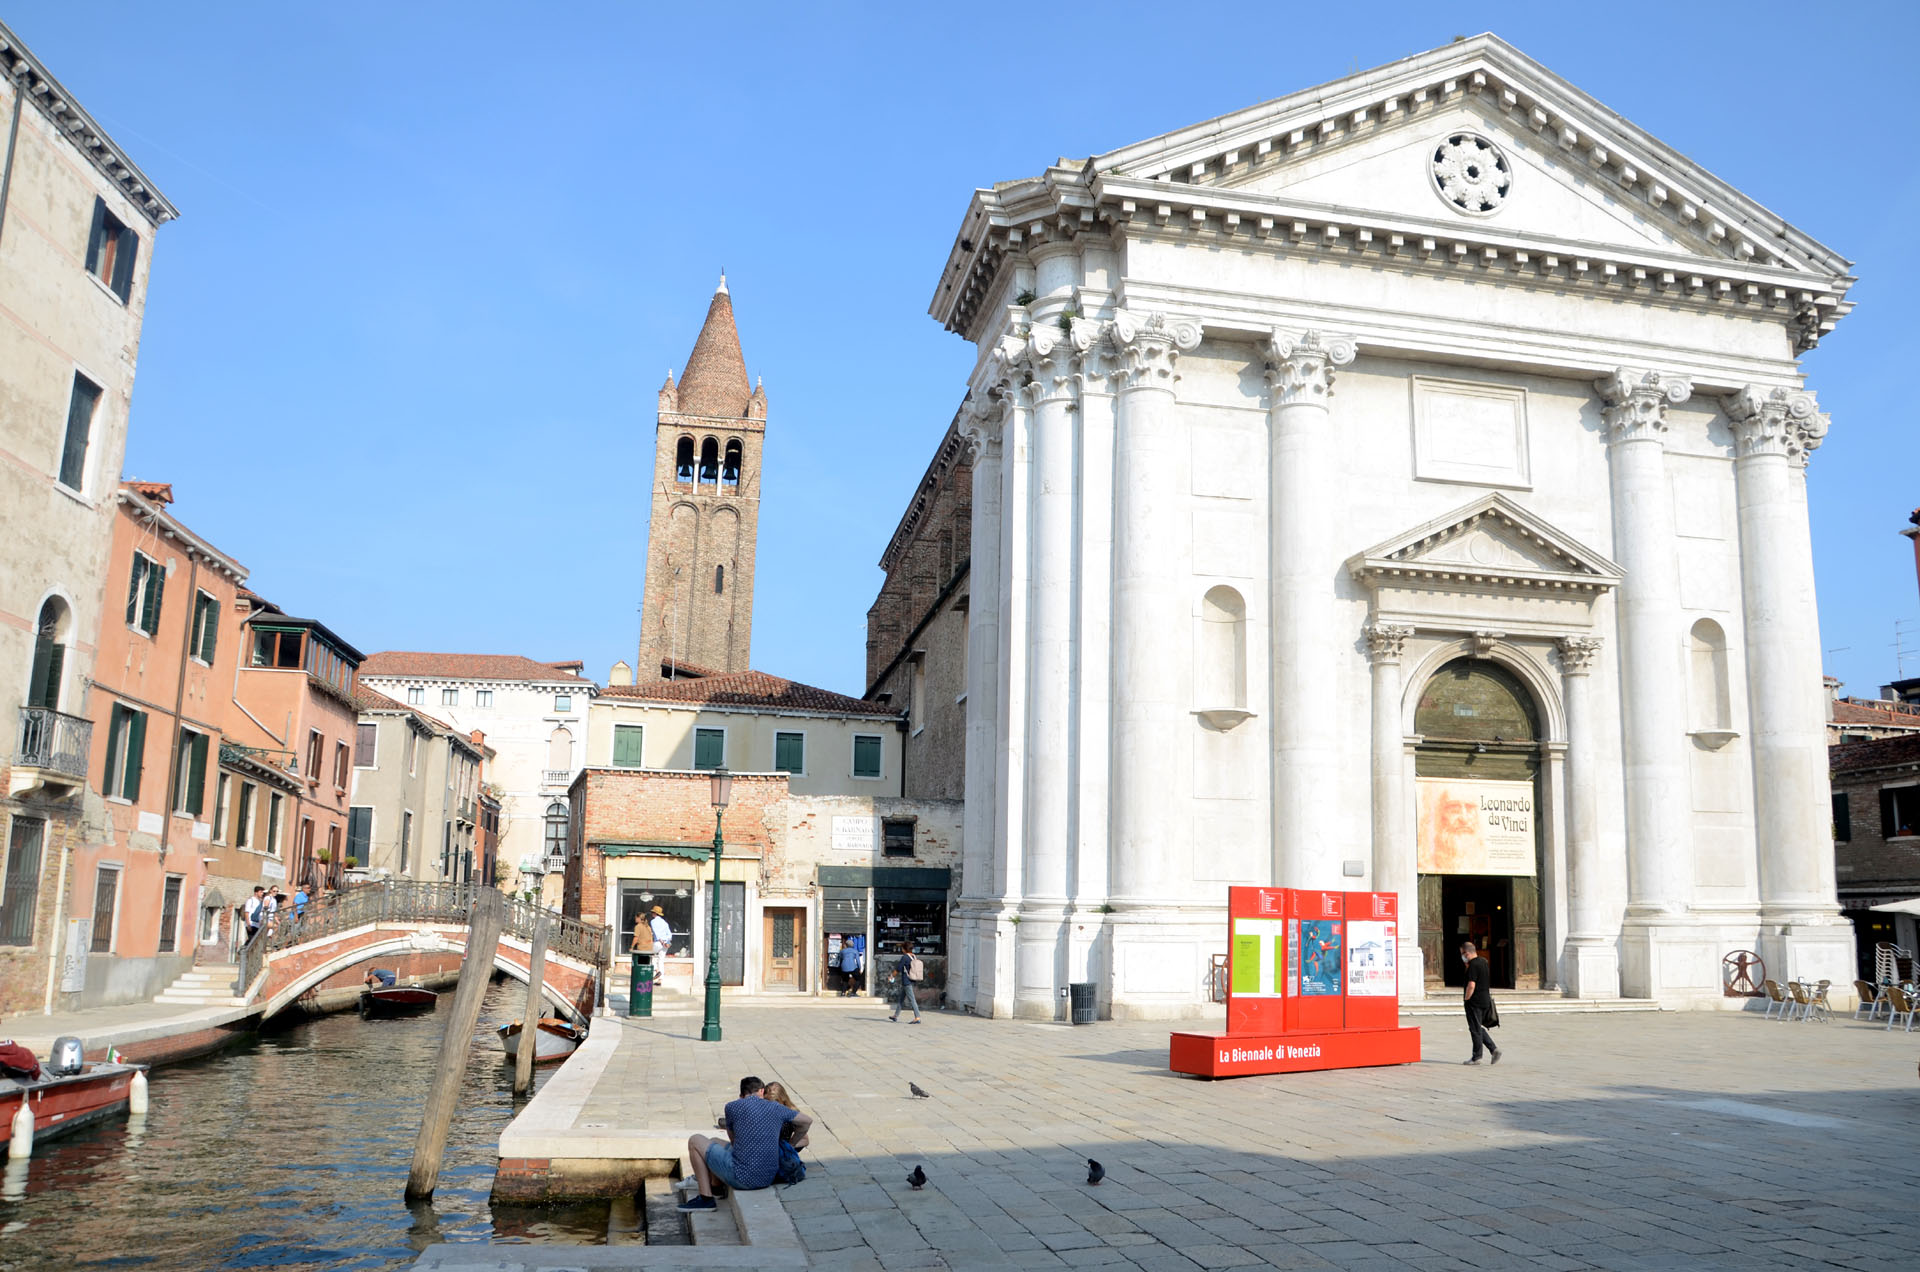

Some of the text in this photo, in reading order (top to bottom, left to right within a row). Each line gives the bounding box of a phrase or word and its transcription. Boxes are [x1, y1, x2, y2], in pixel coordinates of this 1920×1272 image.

[1480, 795, 1531, 811] Leonardo
[1488, 812, 1528, 832] da Vinci
[1219, 1043, 1321, 1063] La Biennale di Venezia
